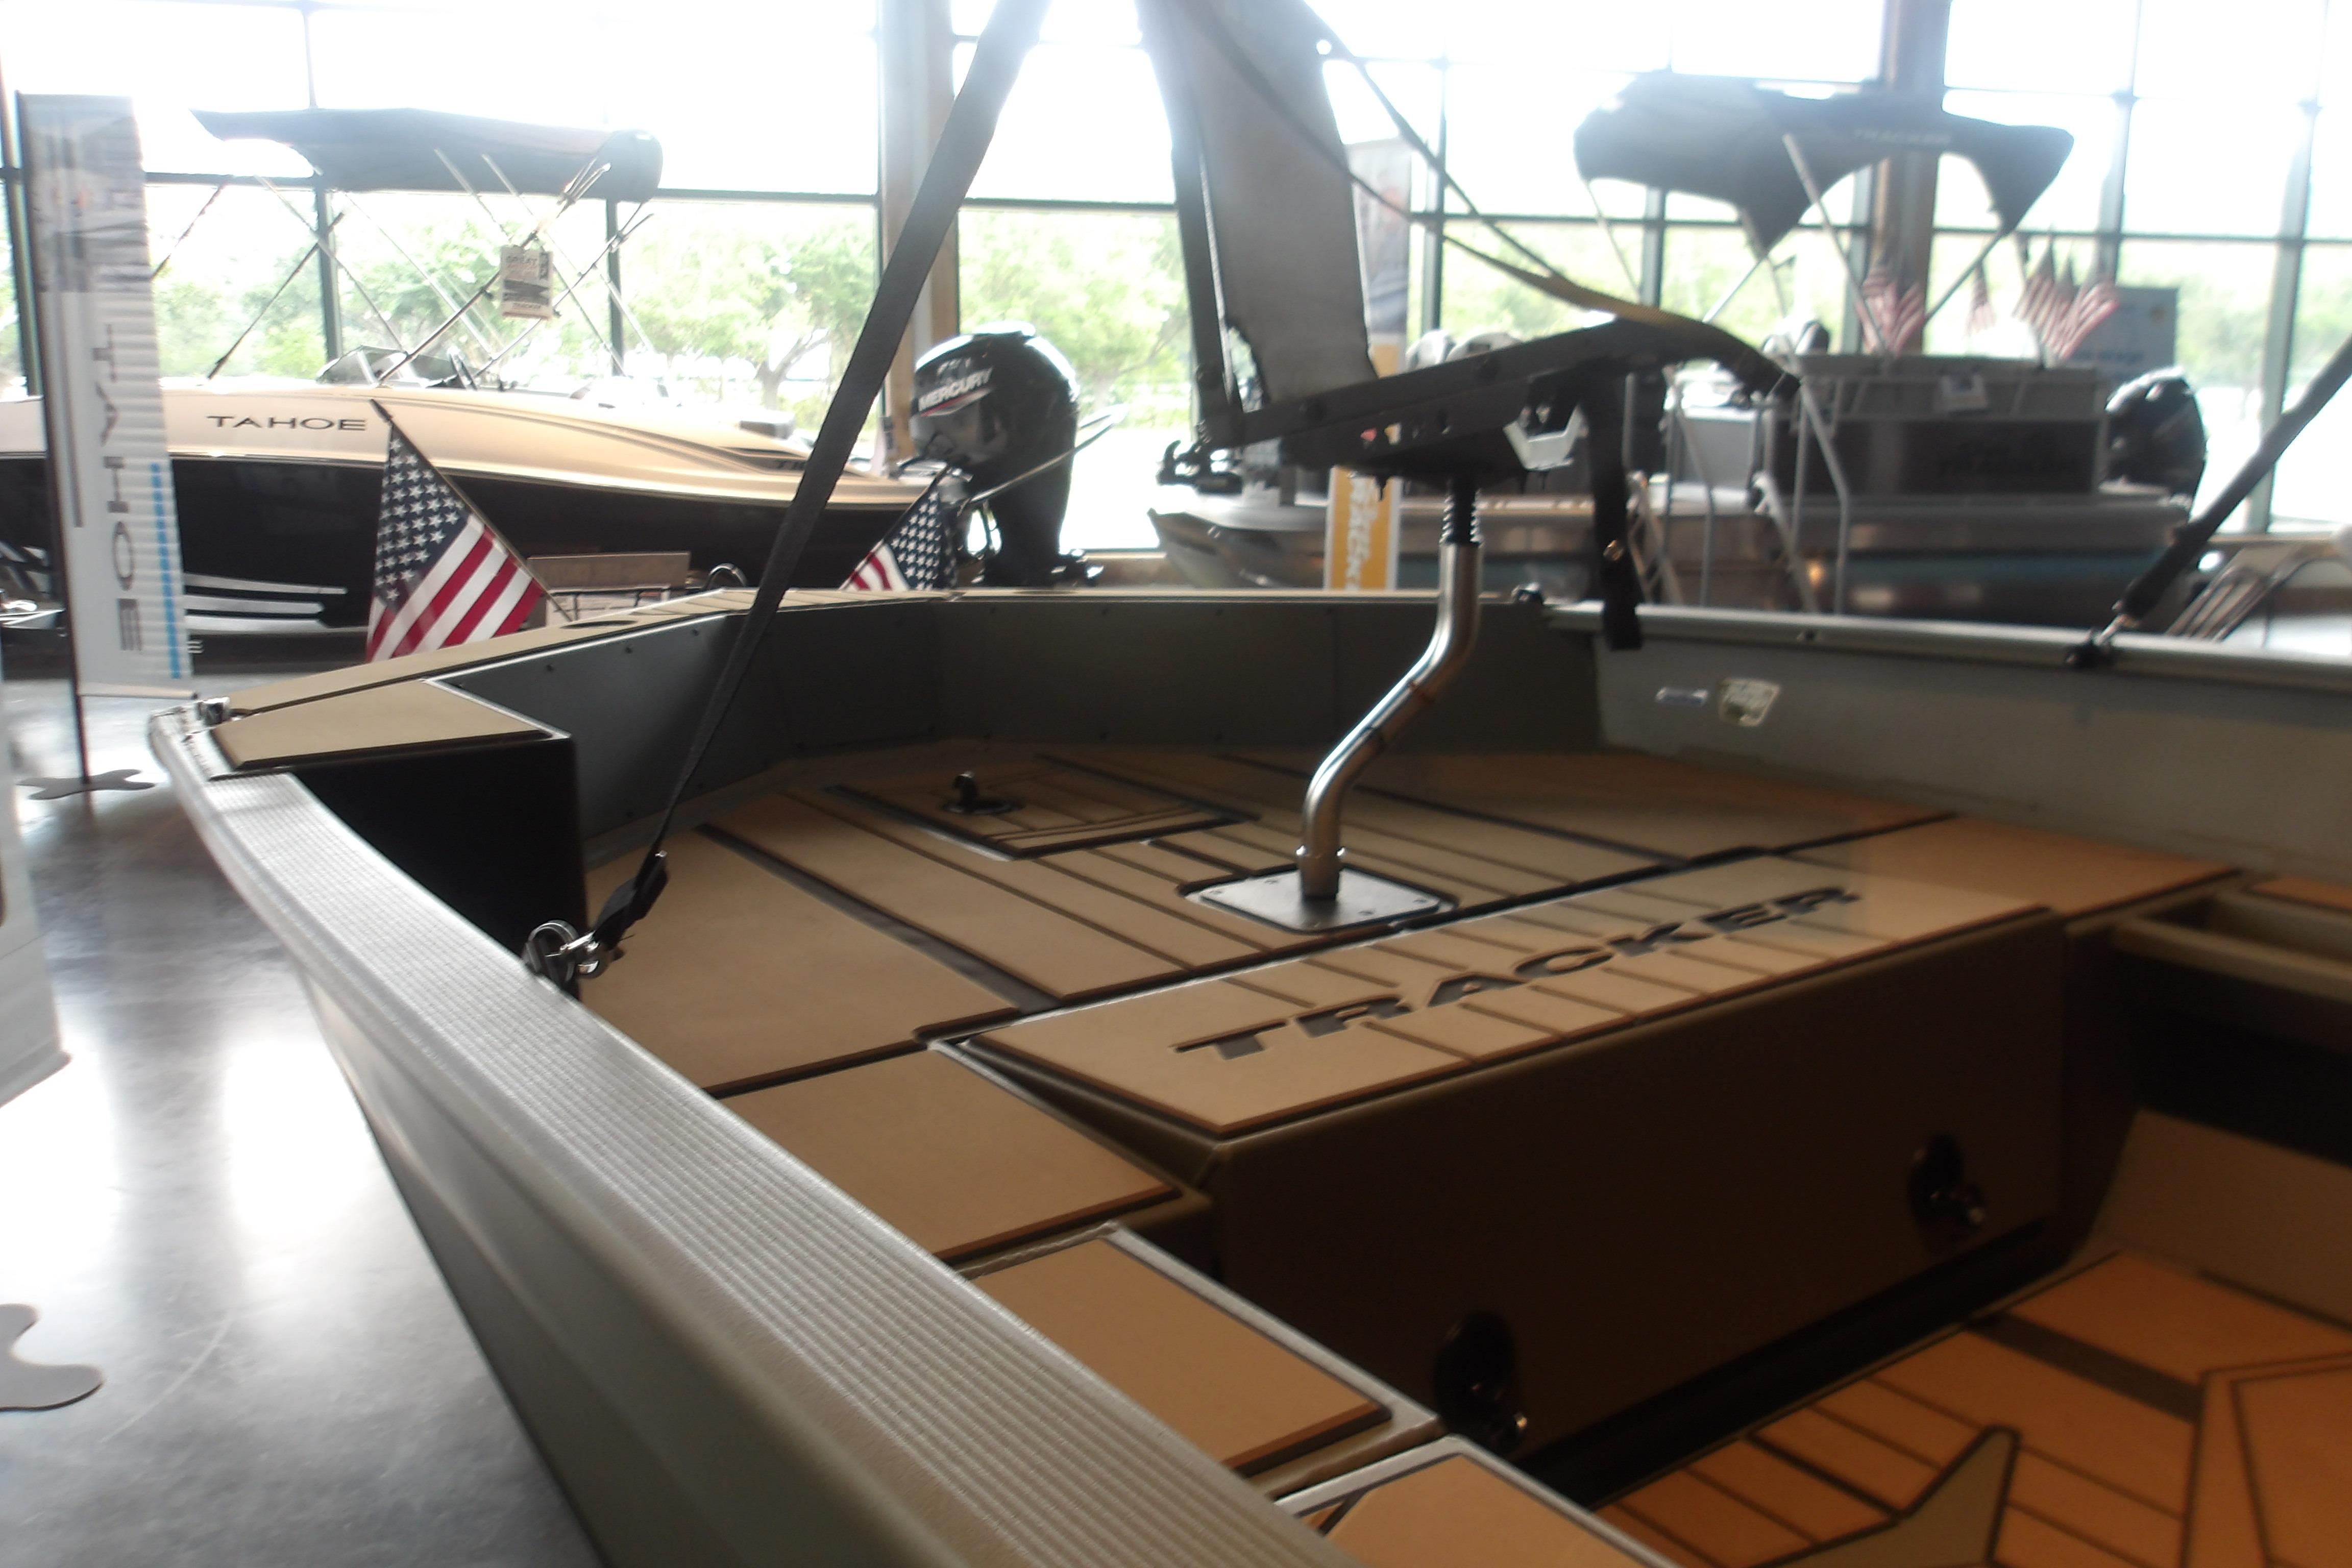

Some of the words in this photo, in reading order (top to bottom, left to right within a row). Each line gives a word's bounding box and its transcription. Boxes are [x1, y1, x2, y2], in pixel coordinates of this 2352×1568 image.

[207, 415, 366, 431] TAHOE
[919, 365, 993, 411] MERCURY
[91, 324, 142, 651] TAHOE
[1173, 886, 1861, 1061] TRACKER
